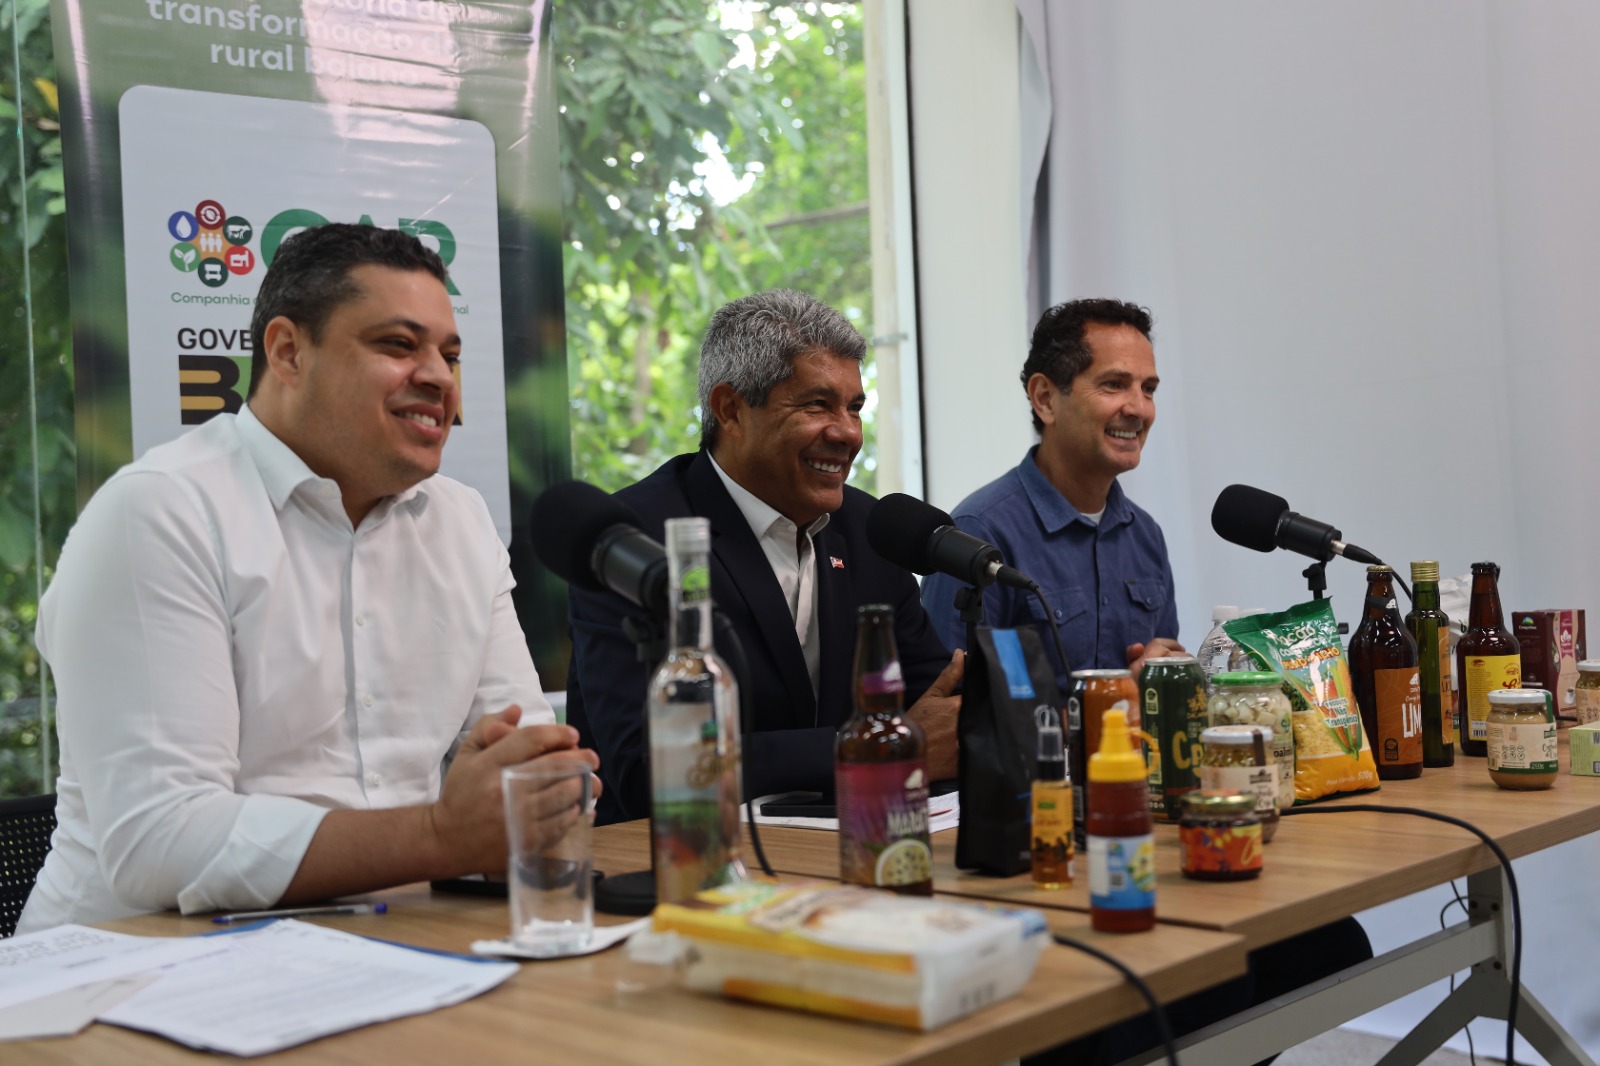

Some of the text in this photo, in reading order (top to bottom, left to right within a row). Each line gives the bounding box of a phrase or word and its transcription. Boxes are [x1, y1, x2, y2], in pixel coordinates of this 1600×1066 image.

[210, 44, 294, 71] rural
[171, 292, 250, 306] Companhia
[178, 327, 254, 350] GOVE
